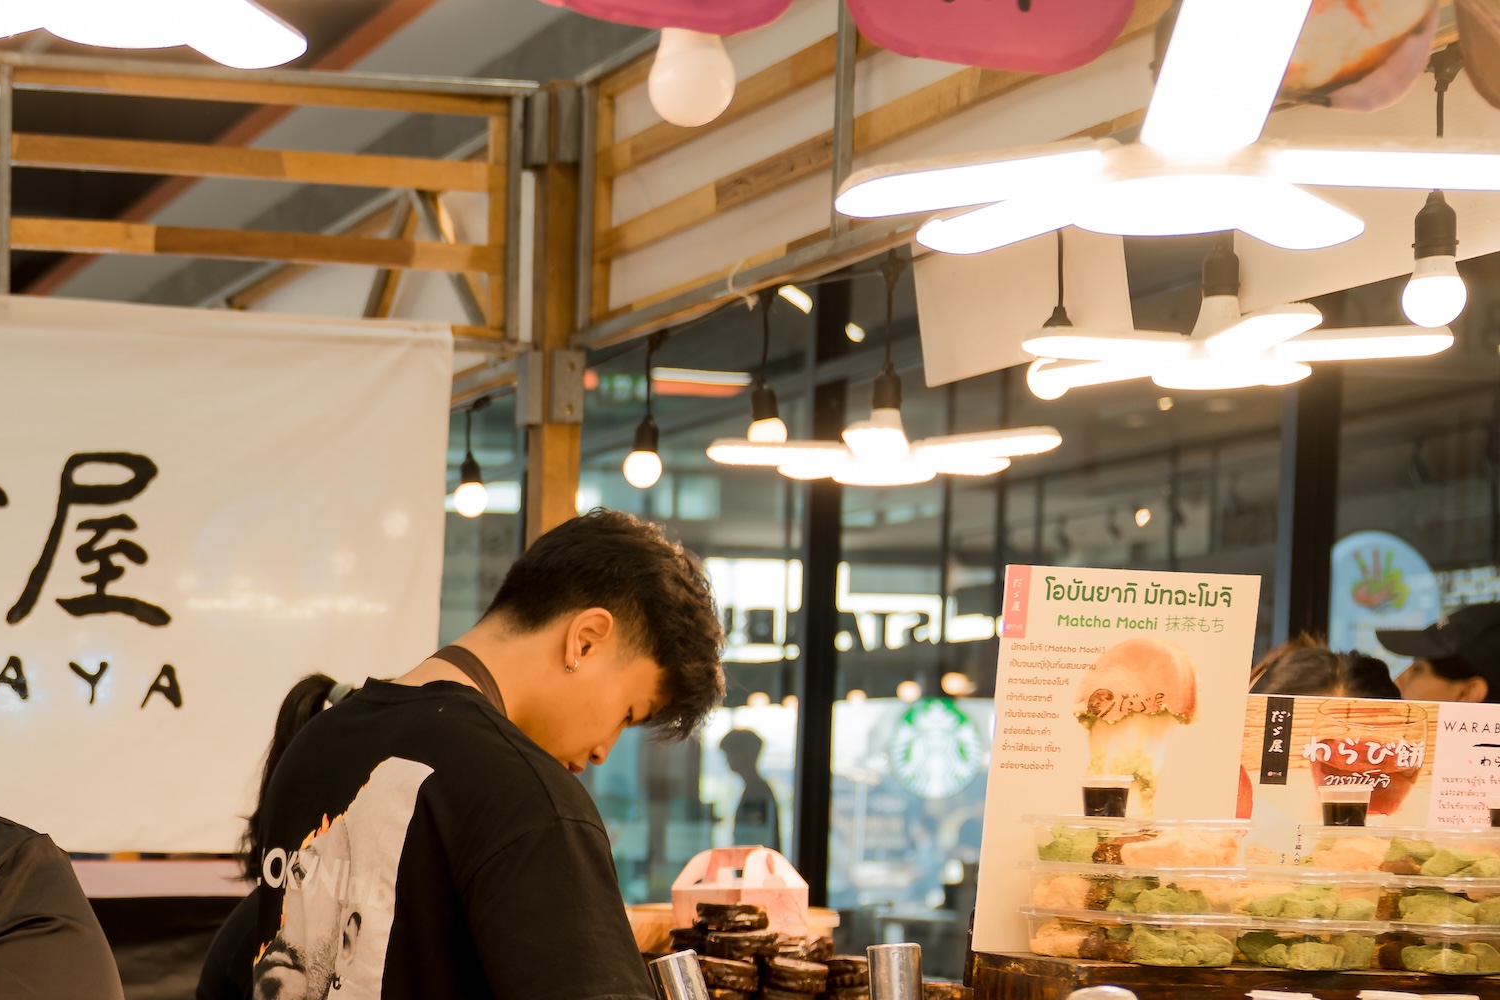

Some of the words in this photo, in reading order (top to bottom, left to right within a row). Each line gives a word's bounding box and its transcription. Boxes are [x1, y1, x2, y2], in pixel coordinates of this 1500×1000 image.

[1045, 576, 1138, 604] โอบันยากิ
[1145, 582, 1233, 608] มัทฉะโมจิ
[1057, 614, 1111, 629] Matcha
[1116, 616, 1158, 630] Mochi
[1165, 615, 1225, 633] 抹茶もち
[1444, 721, 1500, 733] WARAB
[1302, 735, 1425, 769] わらび餅
